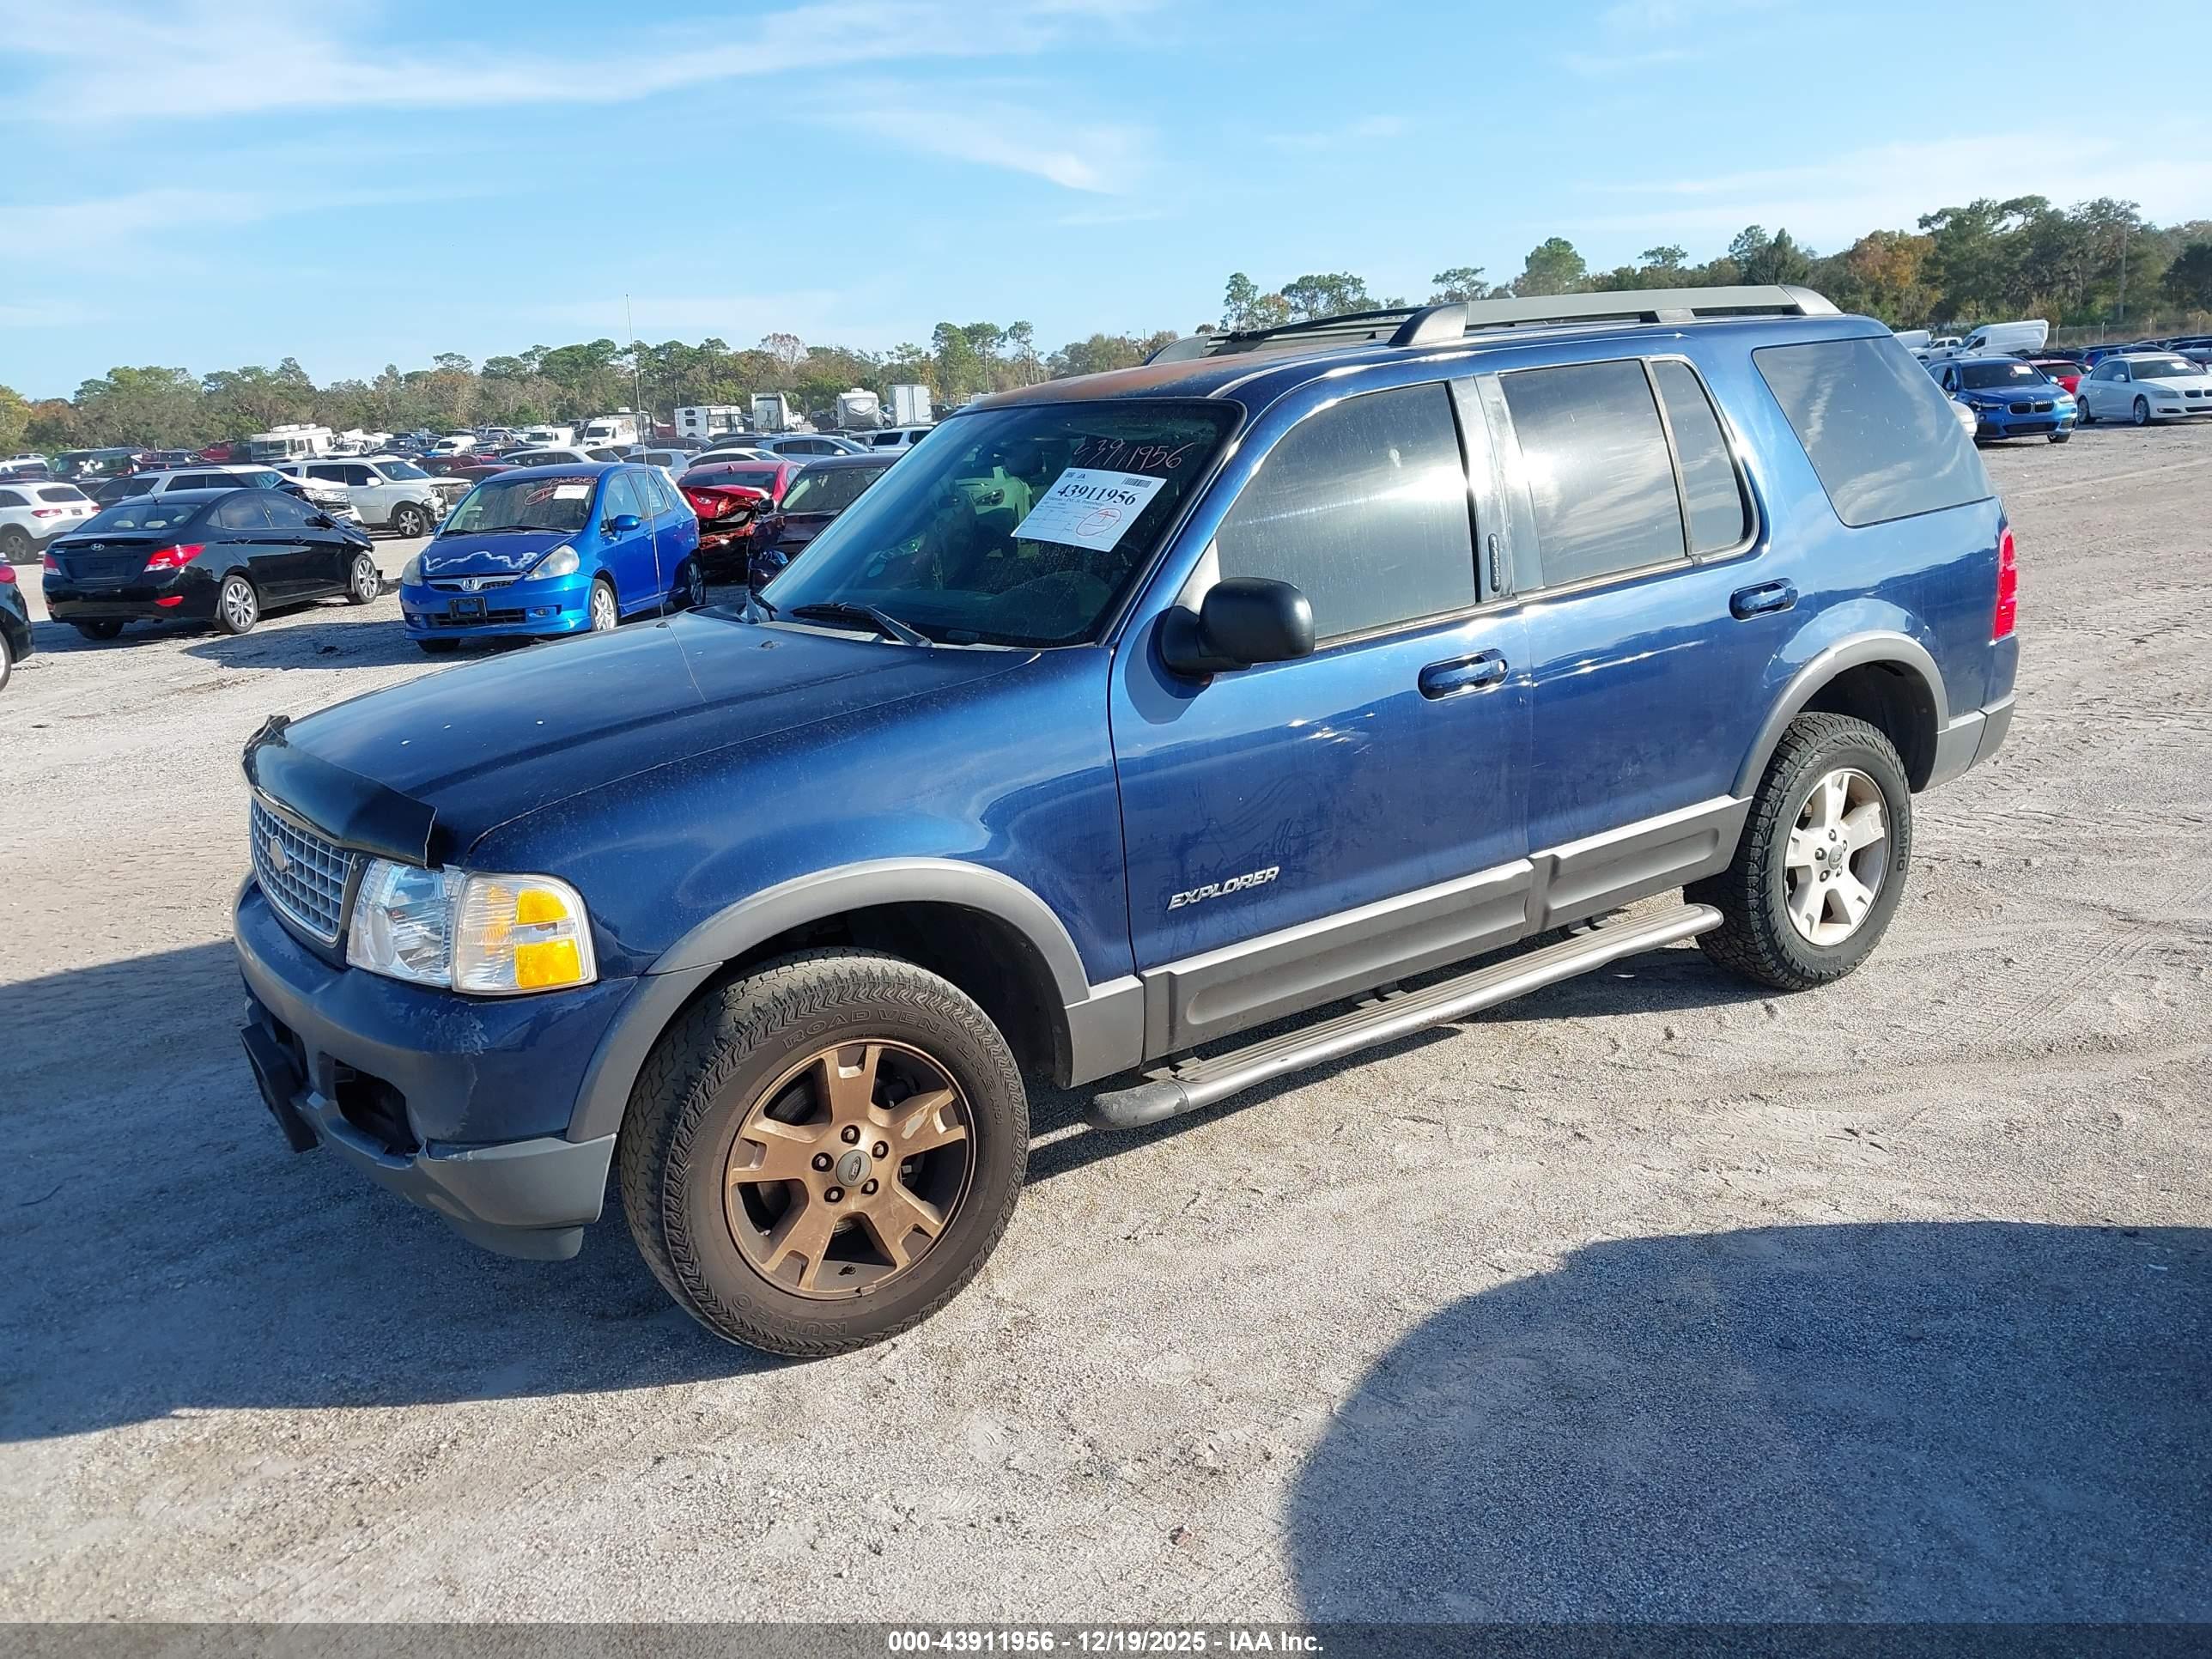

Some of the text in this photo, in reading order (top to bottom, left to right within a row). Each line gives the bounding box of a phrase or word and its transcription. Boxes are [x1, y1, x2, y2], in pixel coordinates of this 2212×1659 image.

[1057, 483, 1141, 506] 43911956
[1896, 805, 1909, 872] KUMHO
[1166, 866, 1280, 911] EXPLORER
[732, 1291, 848, 1337] KUMHO
